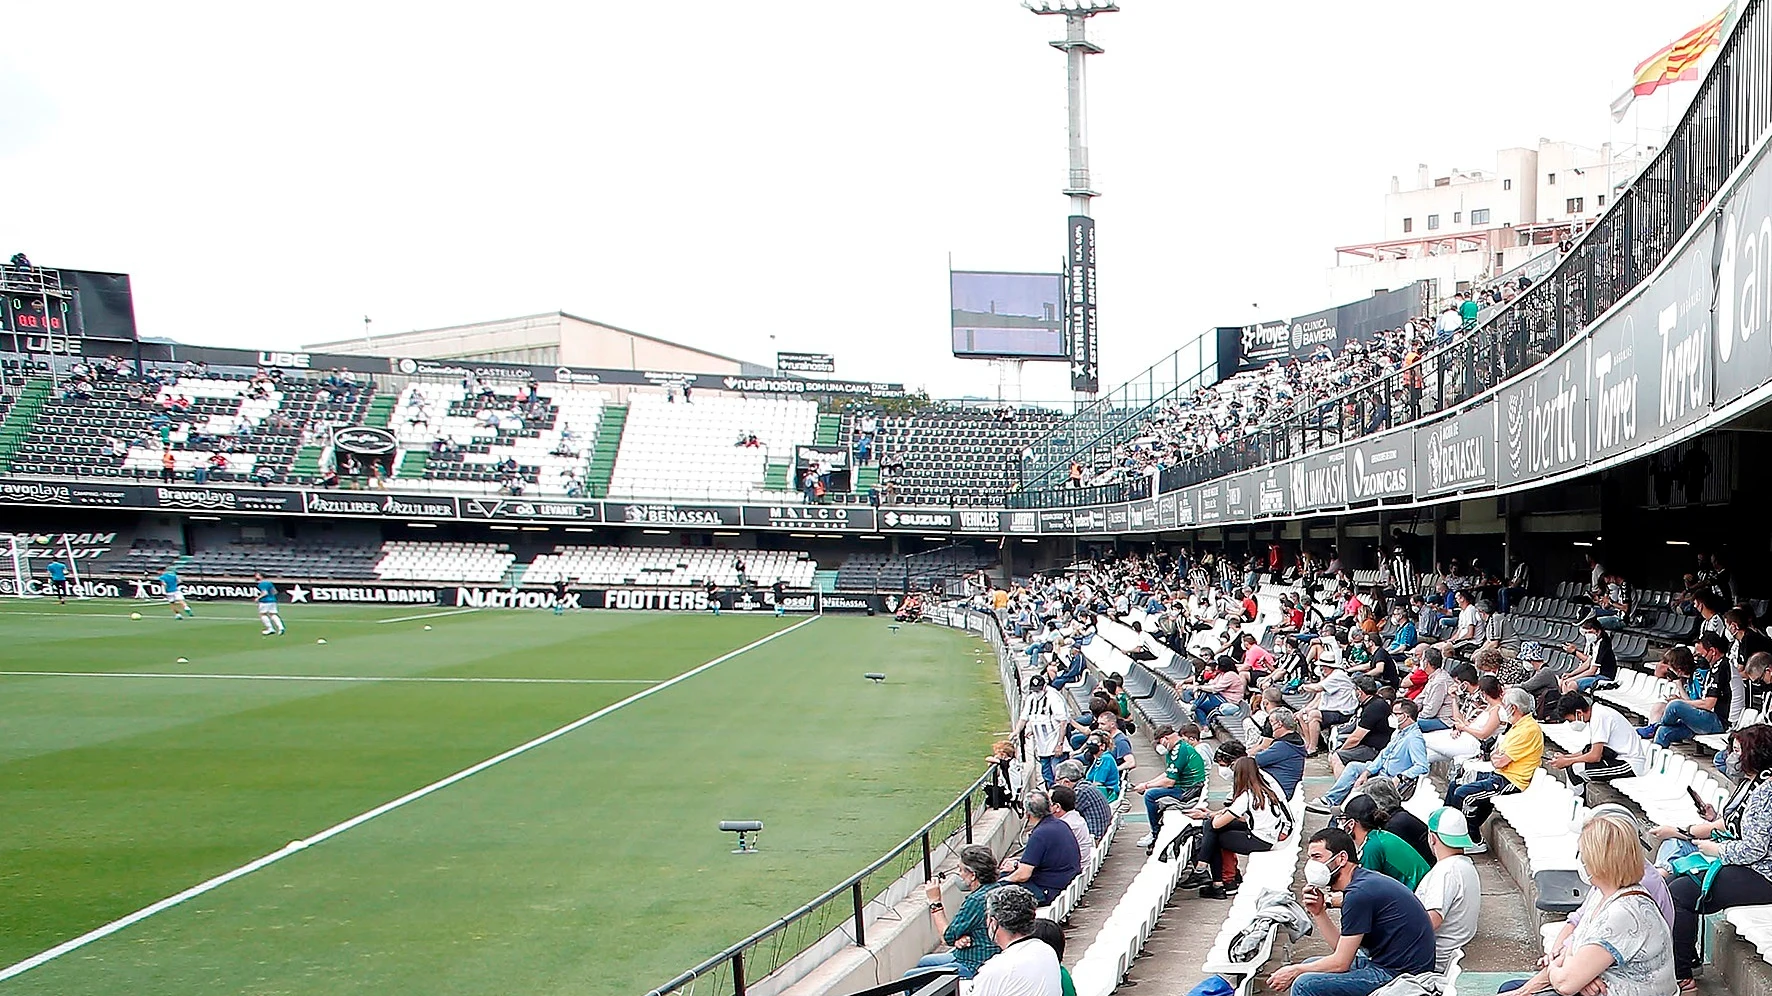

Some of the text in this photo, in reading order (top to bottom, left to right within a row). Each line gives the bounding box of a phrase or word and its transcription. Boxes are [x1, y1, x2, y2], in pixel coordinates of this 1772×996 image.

[1072, 265, 1084, 303] DAMM
[1074, 306, 1084, 361] ESTRELLA
[1256, 324, 1290, 348] Proyes
[1303, 327, 1337, 346] BAVIERA
[27, 337, 81, 353] UBE
[259, 352, 310, 367] UBE
[737, 378, 804, 393] ruralnostra
[806, 383, 826, 391] SOM
[826, 384, 844, 392] UNA
[845, 385, 870, 393] CAIXA
[1527, 359, 1578, 474] ibertic
[1441, 435, 1486, 484] BENASSAL
[0, 483, 69, 497] ravoplaya
[158, 488, 236, 503] Bravoplaya
[320, 500, 380, 513] AZULIBER
[394, 503, 452, 516] AZULIBER
[541, 505, 578, 516] LEVANTE
[649, 511, 722, 524] BENASSAL
[901, 514, 951, 526] SUZUKI
[960, 512, 1000, 527] VEHICLES
[312, 587, 436, 602] ESTRELLA DAMM
[456, 587, 581, 608] Nutrinovx
[605, 589, 708, 610] FOOTTERS
